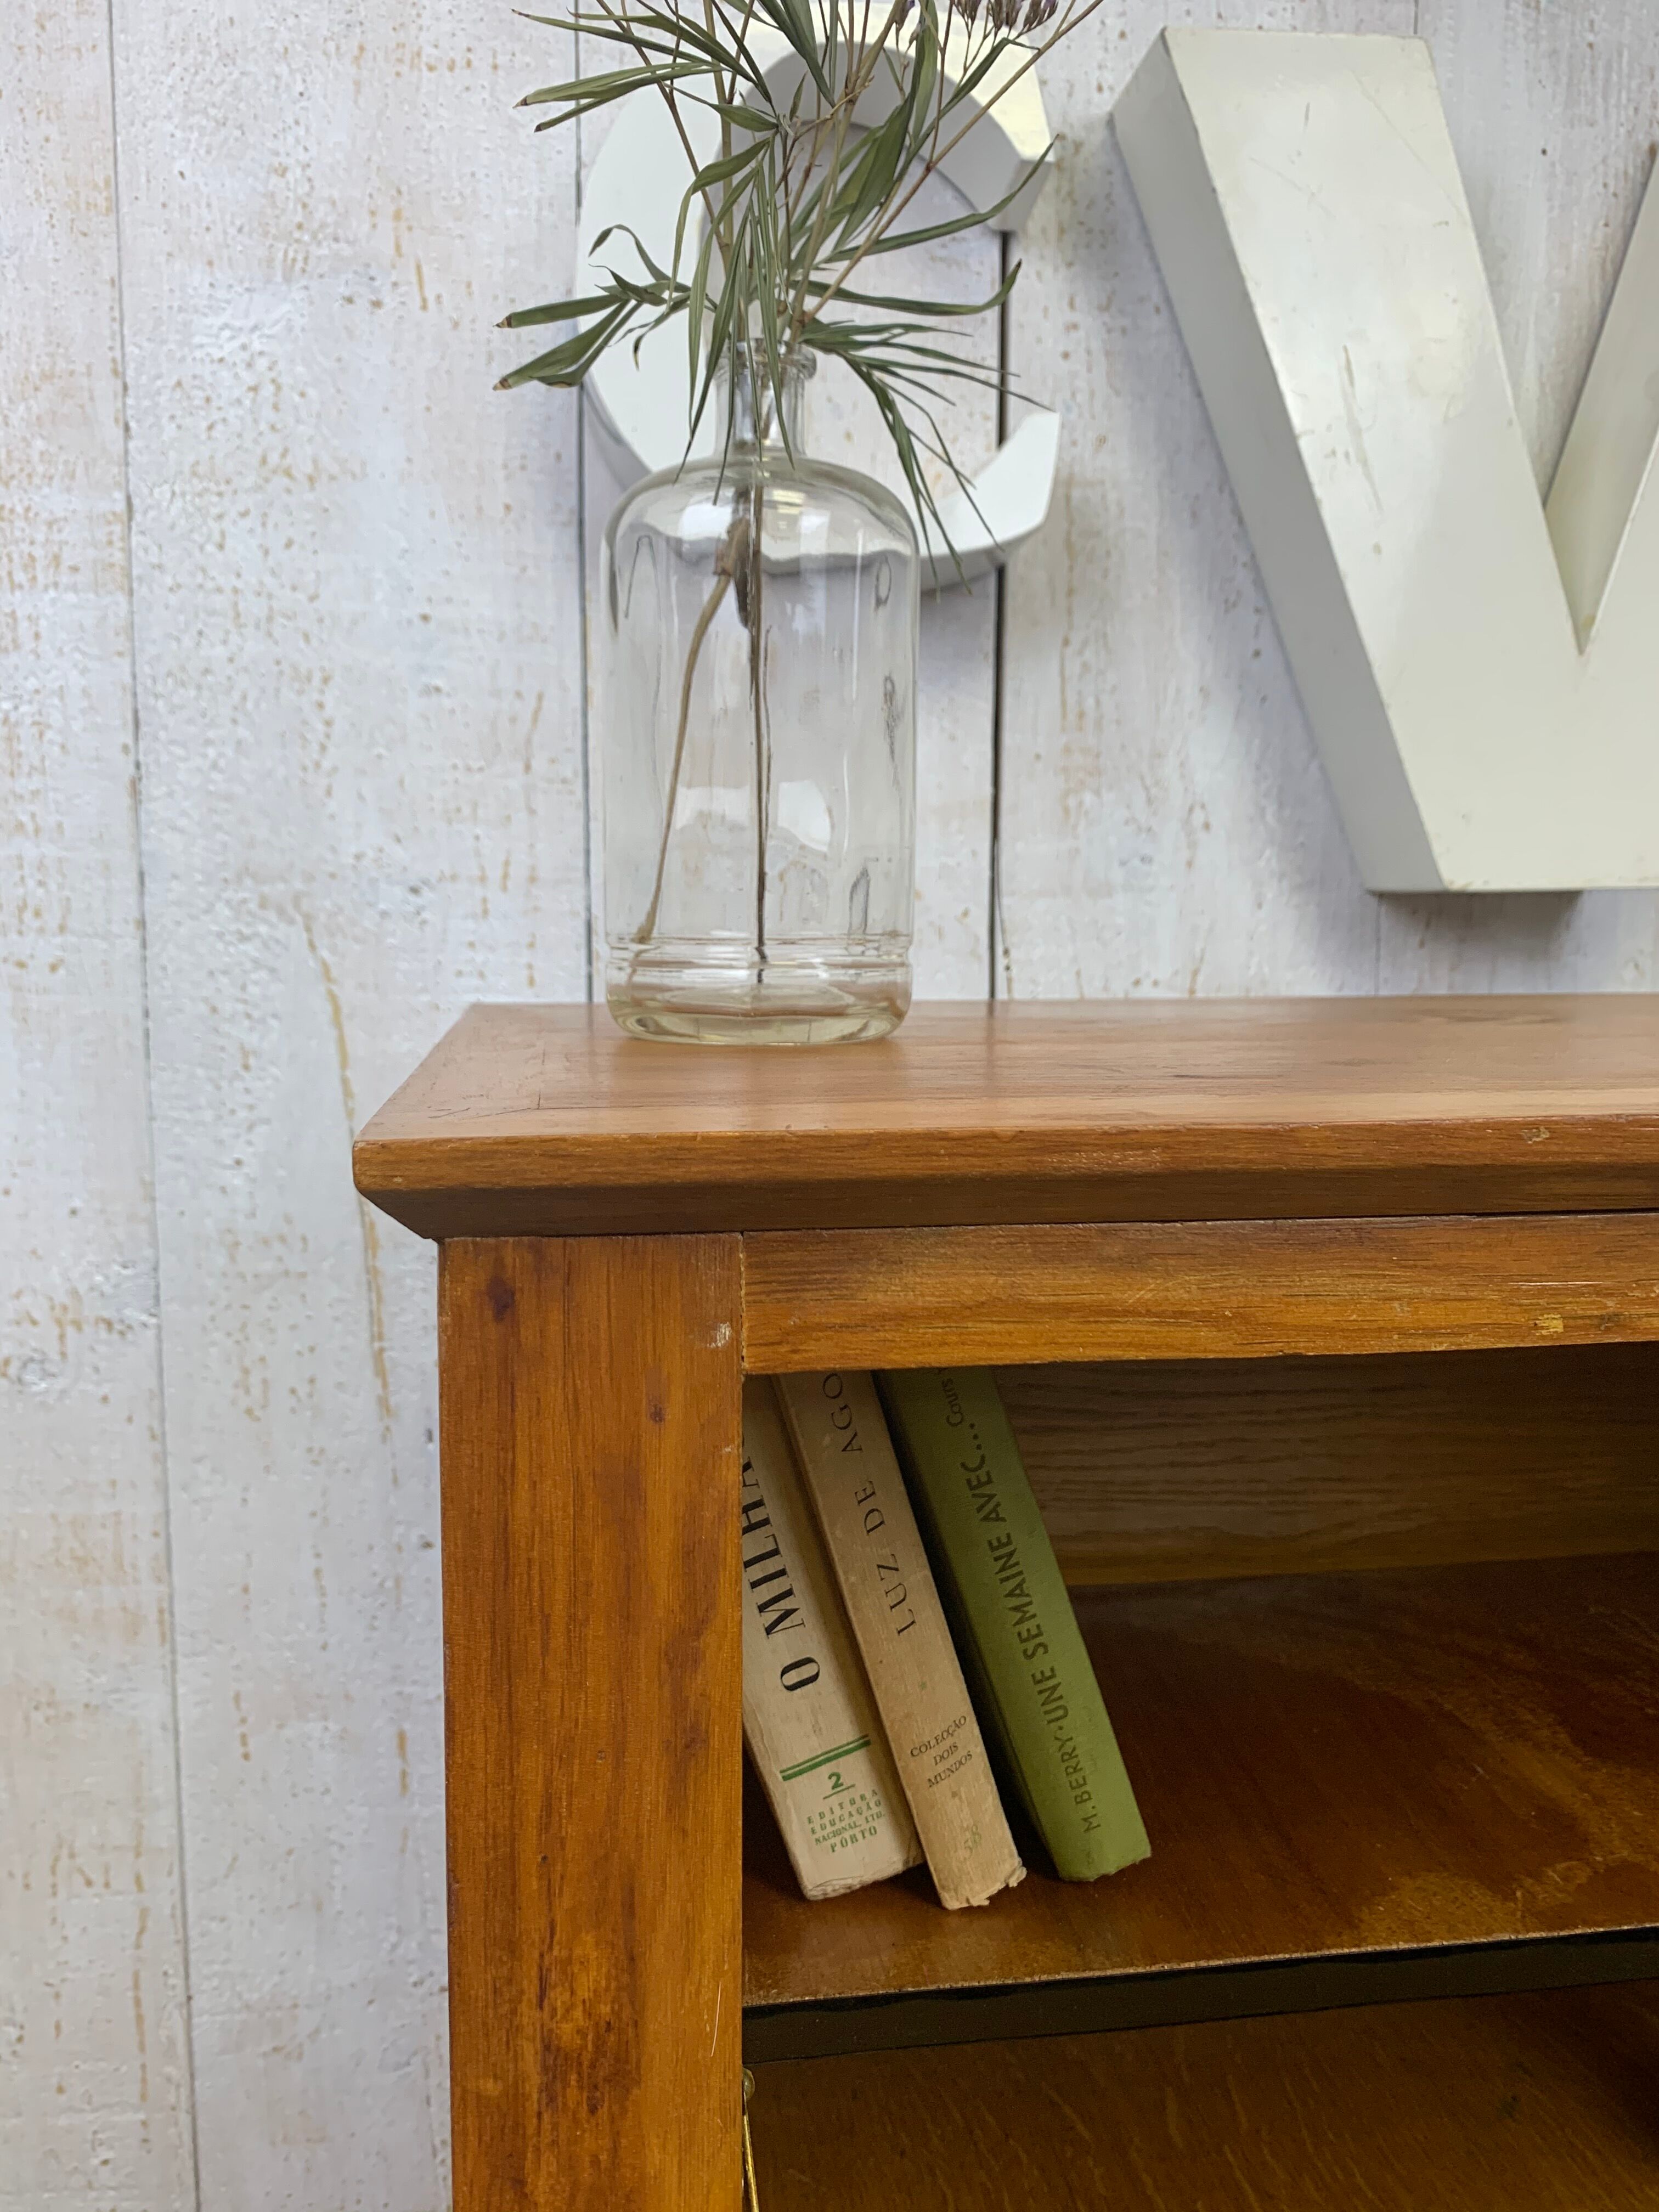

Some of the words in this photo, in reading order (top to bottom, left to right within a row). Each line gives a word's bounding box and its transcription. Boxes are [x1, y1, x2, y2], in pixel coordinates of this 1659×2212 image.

[822, 1373, 863, 1453] AGO
[941, 1378, 964, 1426] Cours
[854, 1480, 885, 1536] DE
[877, 1553, 917, 1636] LUZ
[986, 1532, 1049, 1661] SEMAINE
[780, 1656, 820, 1692] O
[1030, 1666, 1069, 1725] UNE
[927, 1750, 973, 1788] MUNDOS
[933, 1741, 959, 1766] DOIS
[827, 1771, 844, 1790] 2
[806, 1789, 878, 1824] EDITORA
[810, 1798, 882, 1836] EDUCAÇÃO
